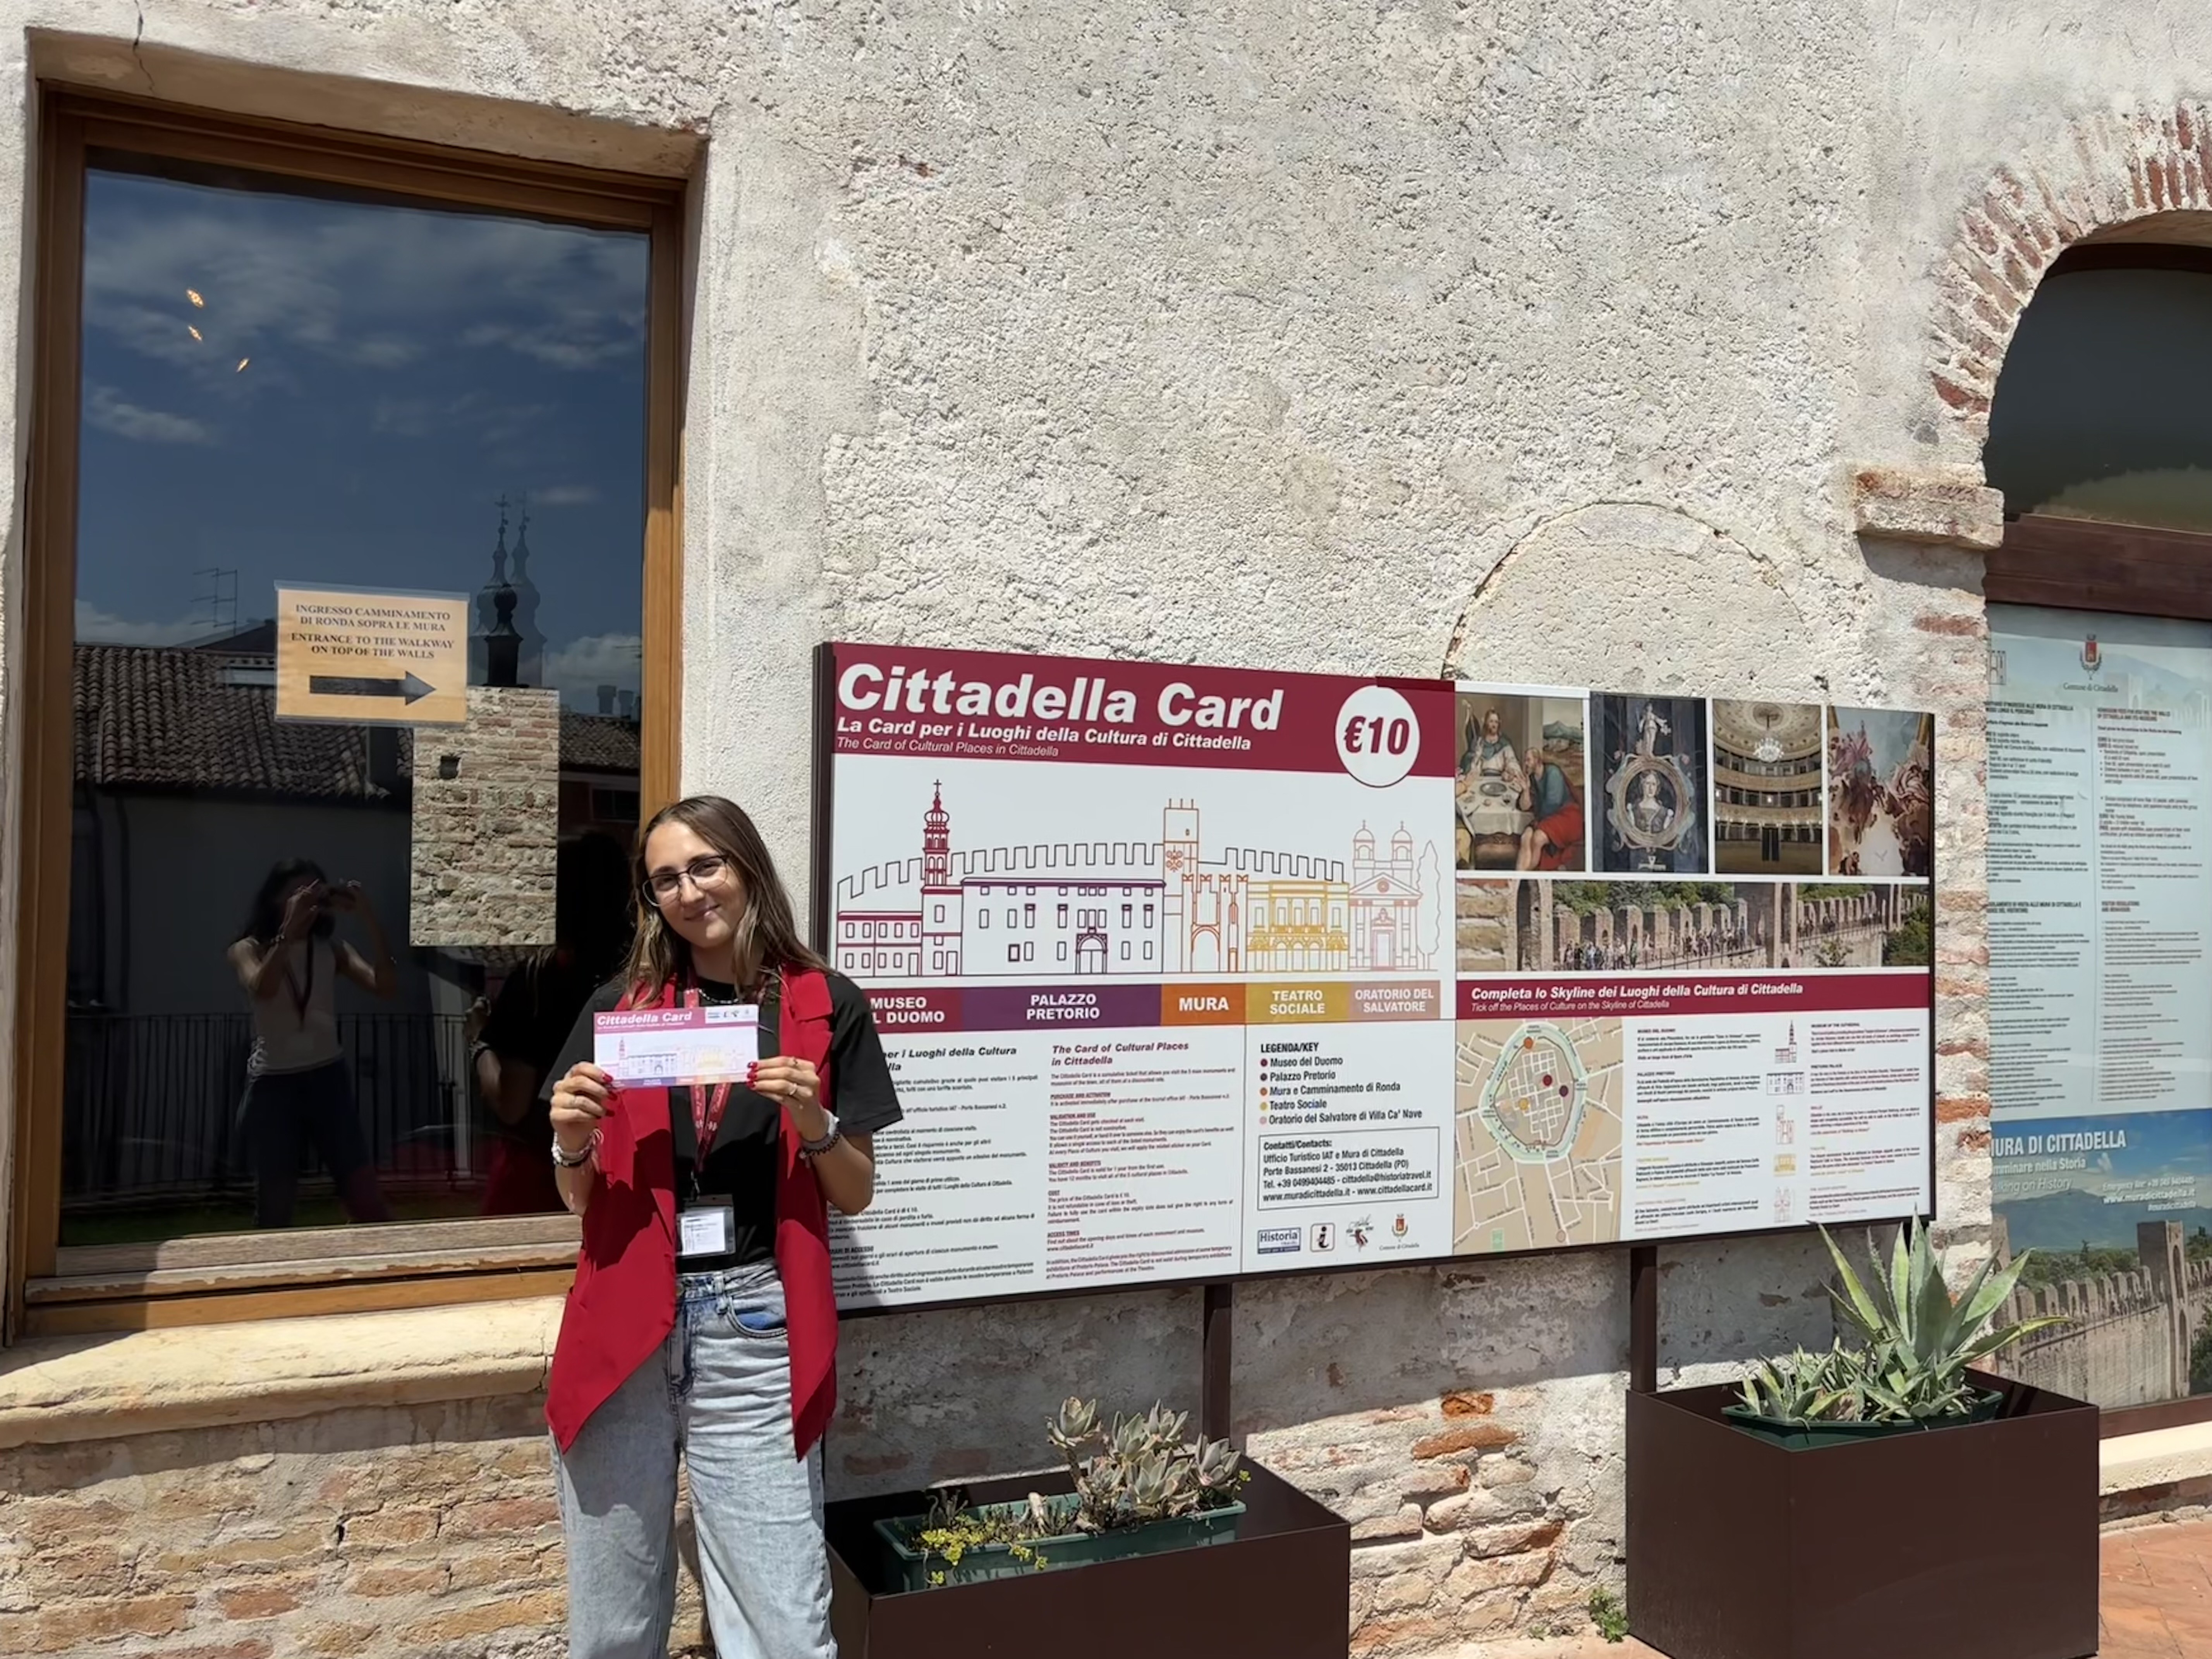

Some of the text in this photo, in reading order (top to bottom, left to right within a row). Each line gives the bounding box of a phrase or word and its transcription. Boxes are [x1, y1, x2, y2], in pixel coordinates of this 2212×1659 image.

[296, 604, 450, 620] INGRESSO CAMMINAMENTO
[301, 616, 445, 632] DI RONDA SOPRA LE MURA
[292, 633, 454, 649] ENTRANCE TO THE WALKWAY
[311, 645, 434, 659] ON TOP OF THE WALLS
[838, 664, 1283, 730] Cittadella Card
[838, 717, 1250, 750] La Card per i Luoghi della Cultura di Cittadella
[1344, 716, 1409, 754] €10
[838, 737, 1058, 756] The Card of Cultural Places in Cittadella
[1273, 990, 1322, 1001] TEATRO
[1355, 989, 1434, 1000] ORATORIO DEL
[1472, 983, 1803, 1001] Completa lo Skyline dei Luoghi della Cultura di Cittadella
[870, 997, 927, 1009] MUSEO
[1031, 994, 1096, 1005] PALAZZO
[1180, 997, 1228, 1011] MURA
[1270, 1003, 1324, 1014] SOCIALE
[1364, 1001, 1425, 1012] SALVATORE
[598, 1012, 692, 1025] Cittadella Card
[887, 1011, 944, 1023] DUOMO
[1027, 1008, 1099, 1020] PRETORIO
[909, 1049, 946, 1059] Luoghi
[949, 1048, 974, 1056] della
[979, 1047, 1016, 1055] Cultura
[1101, 1044, 1111, 1052] of
[1116, 1043, 1154, 1051] Cultural
[1261, 1042, 1319, 1053] LEGENDA/KEY
[1064, 1056, 1112, 1065] Cittadella
[1271, 1056, 1343, 1067] Museo del Duomo
[1270, 1071, 1336, 1081] Palazzo Pretorio
[1270, 1087, 1291, 1096] Mura
[1300, 1084, 1364, 1094] Camminamento
[1366, 1083, 1373, 1092] di
[1376, 1082, 1400, 1091] Ronda
[1270, 1099, 1327, 1110] Teatro Sociale
[1269, 1109, 1422, 1124] Oratorio del Salvatore di Villa Ca' Nave
[1264, 1140, 1331, 1150] Contatti/Contacts:
[2029, 1136, 2042, 1154] DI
[2047, 1130, 2126, 1152] CITTADELLA
[1264, 1154, 1287, 1163] Ufficio
[1290, 1152, 1320, 1161] Turistico
[1322, 1151, 1333, 1159] IAT
[1371, 1148, 1404, 1157] Cittadella
[1264, 1168, 1283, 1176] Porte
[1285, 1165, 1321, 1175] Bassanesi
[1336, 1162, 1357, 1172] 35013
[1359, 1161, 1392, 1170] Cittadella
[1394, 1159, 1408, 1170] (PD)
[1263, 1183, 1432, 1201] www.muradicittadella.it www.cittadellacard.it
[1260, 1231, 1297, 1242] Historia
